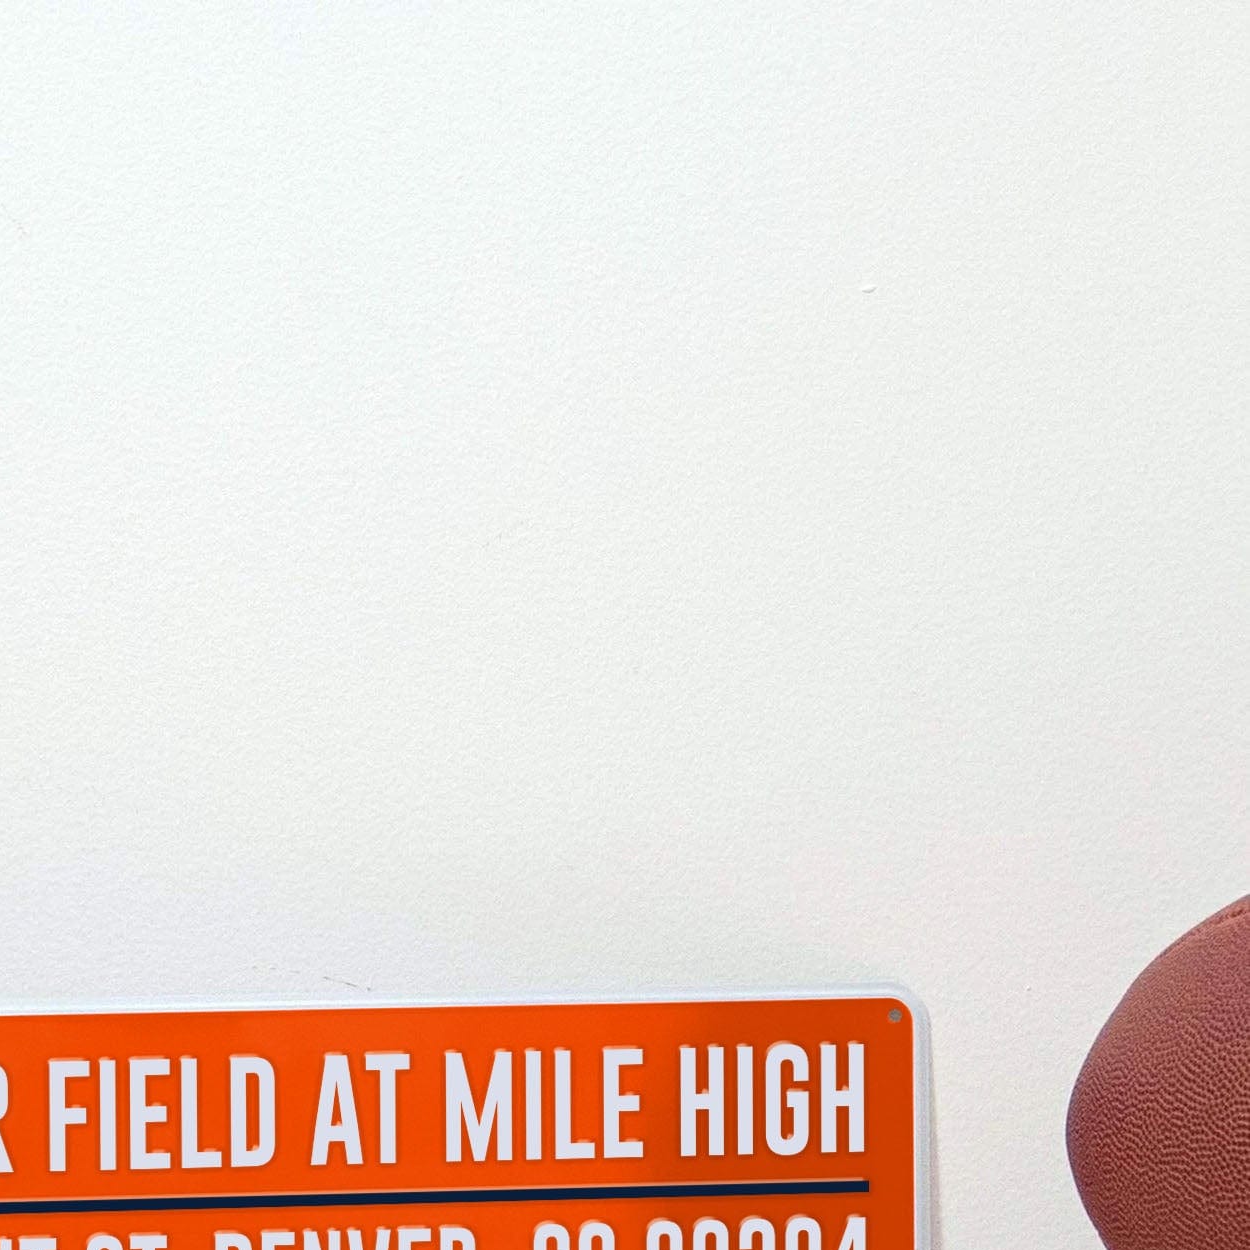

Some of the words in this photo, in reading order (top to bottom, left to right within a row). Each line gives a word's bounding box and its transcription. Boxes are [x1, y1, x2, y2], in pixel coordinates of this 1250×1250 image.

[48, 1054, 276, 1172] FIELD
[310, 1051, 410, 1166] AT
[445, 1046, 644, 1163] MILE
[679, 1041, 865, 1157] HIGH
